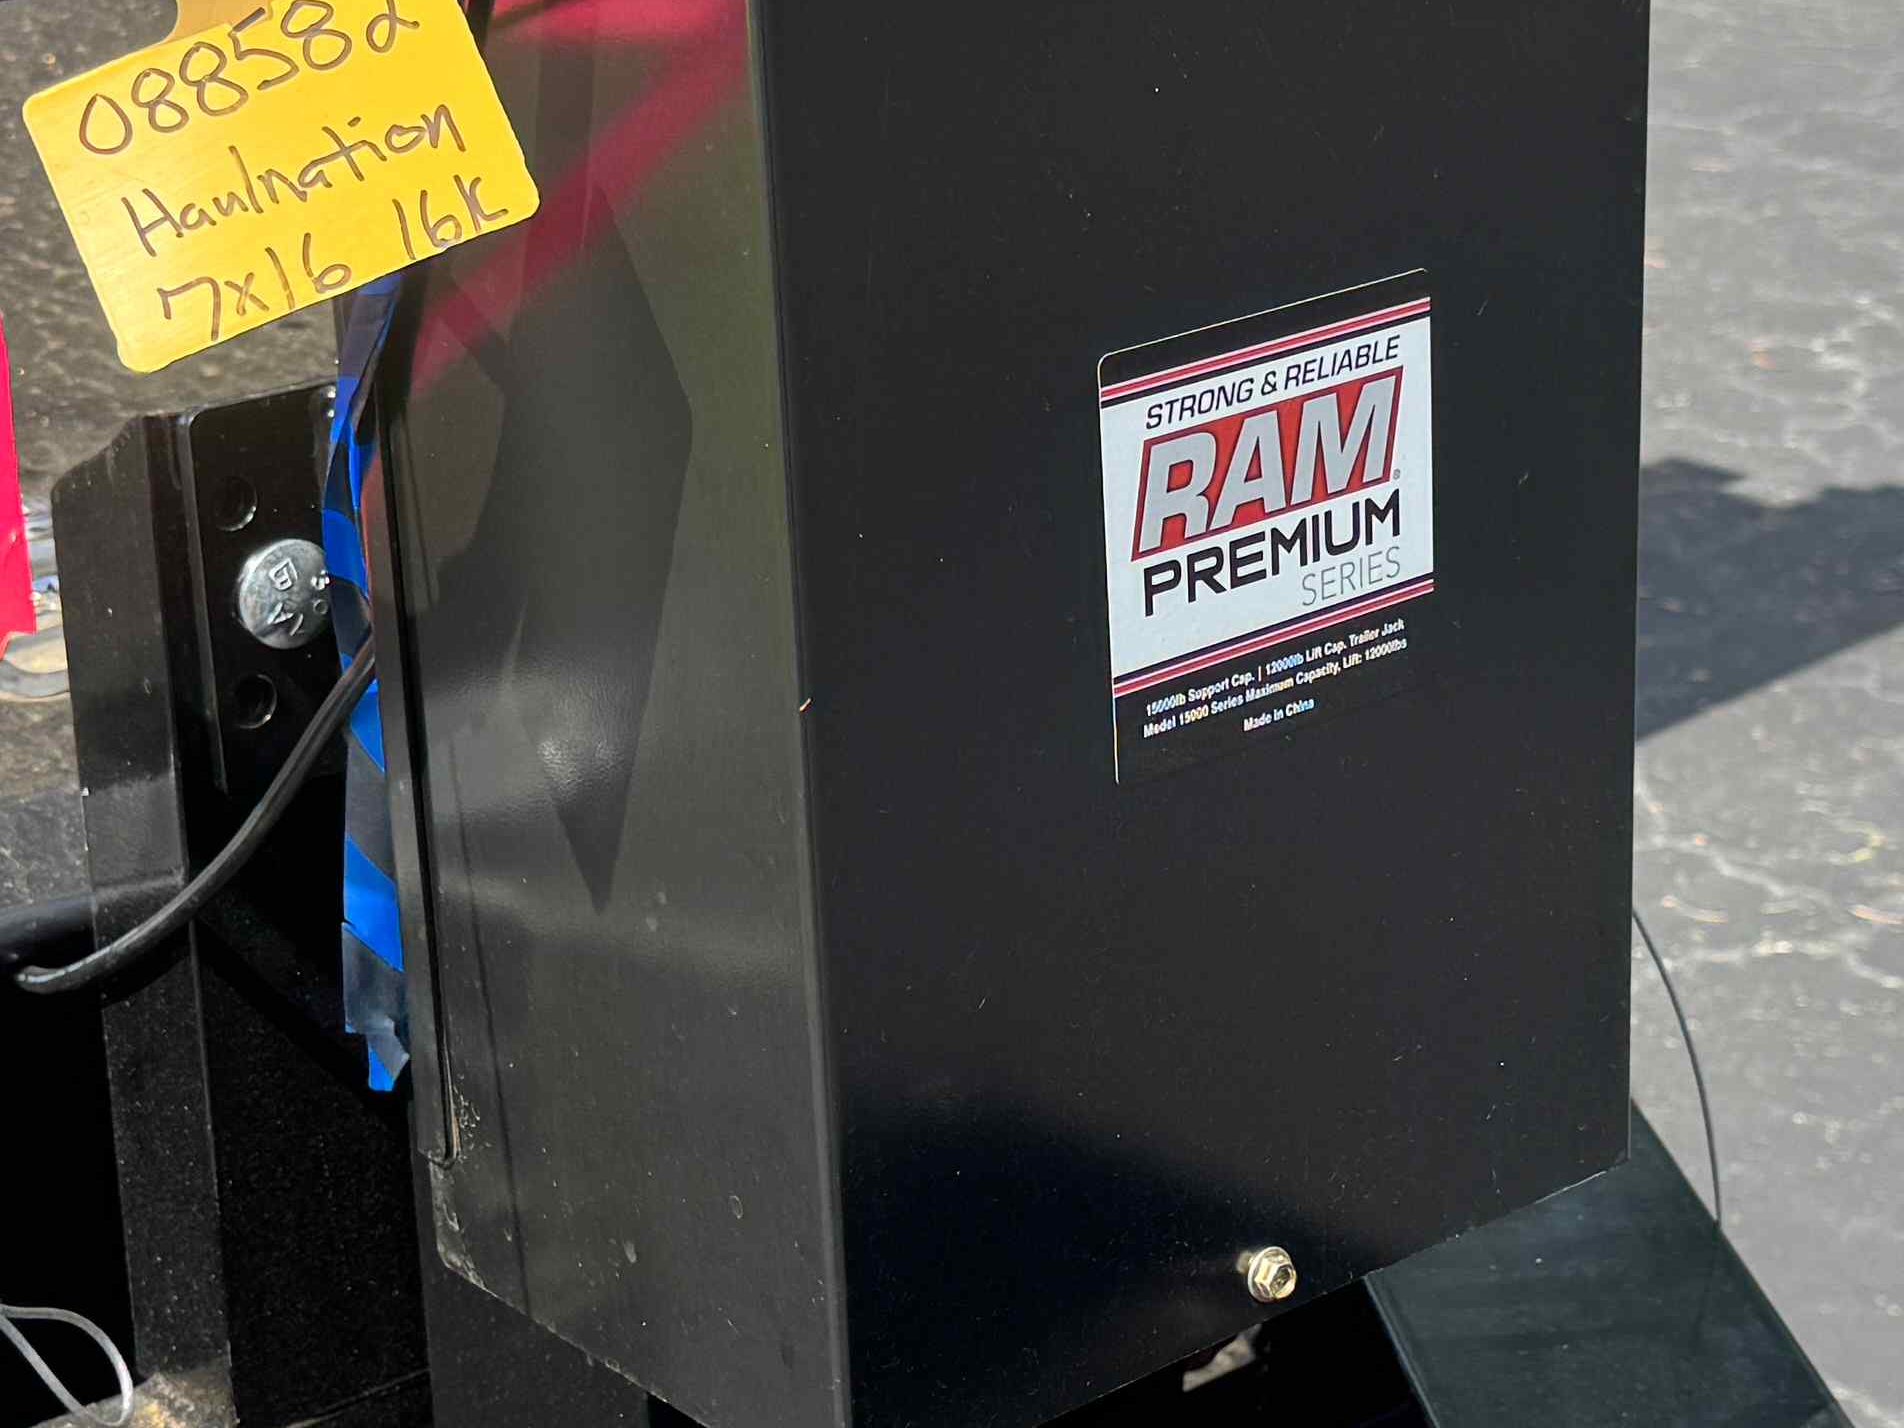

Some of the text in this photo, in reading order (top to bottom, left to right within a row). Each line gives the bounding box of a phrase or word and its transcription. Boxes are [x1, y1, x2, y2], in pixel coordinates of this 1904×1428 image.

[1145, 333, 1401, 431] STRONG & RELIABLE
[1137, 373, 1398, 554] RAM
[1143, 487, 1401, 618] PREMIUM
[1301, 546, 1401, 608] SERIES
[1187, 676, 1230, 702] Support
[1349, 627, 1380, 648] Trailer
[1381, 617, 1405, 637] Jack
[1143, 714, 1177, 739] Model
[1210, 693, 1244, 715] Series
[1245, 677, 1295, 703] Maximum
[1243, 696, 1315, 732] Made in China
